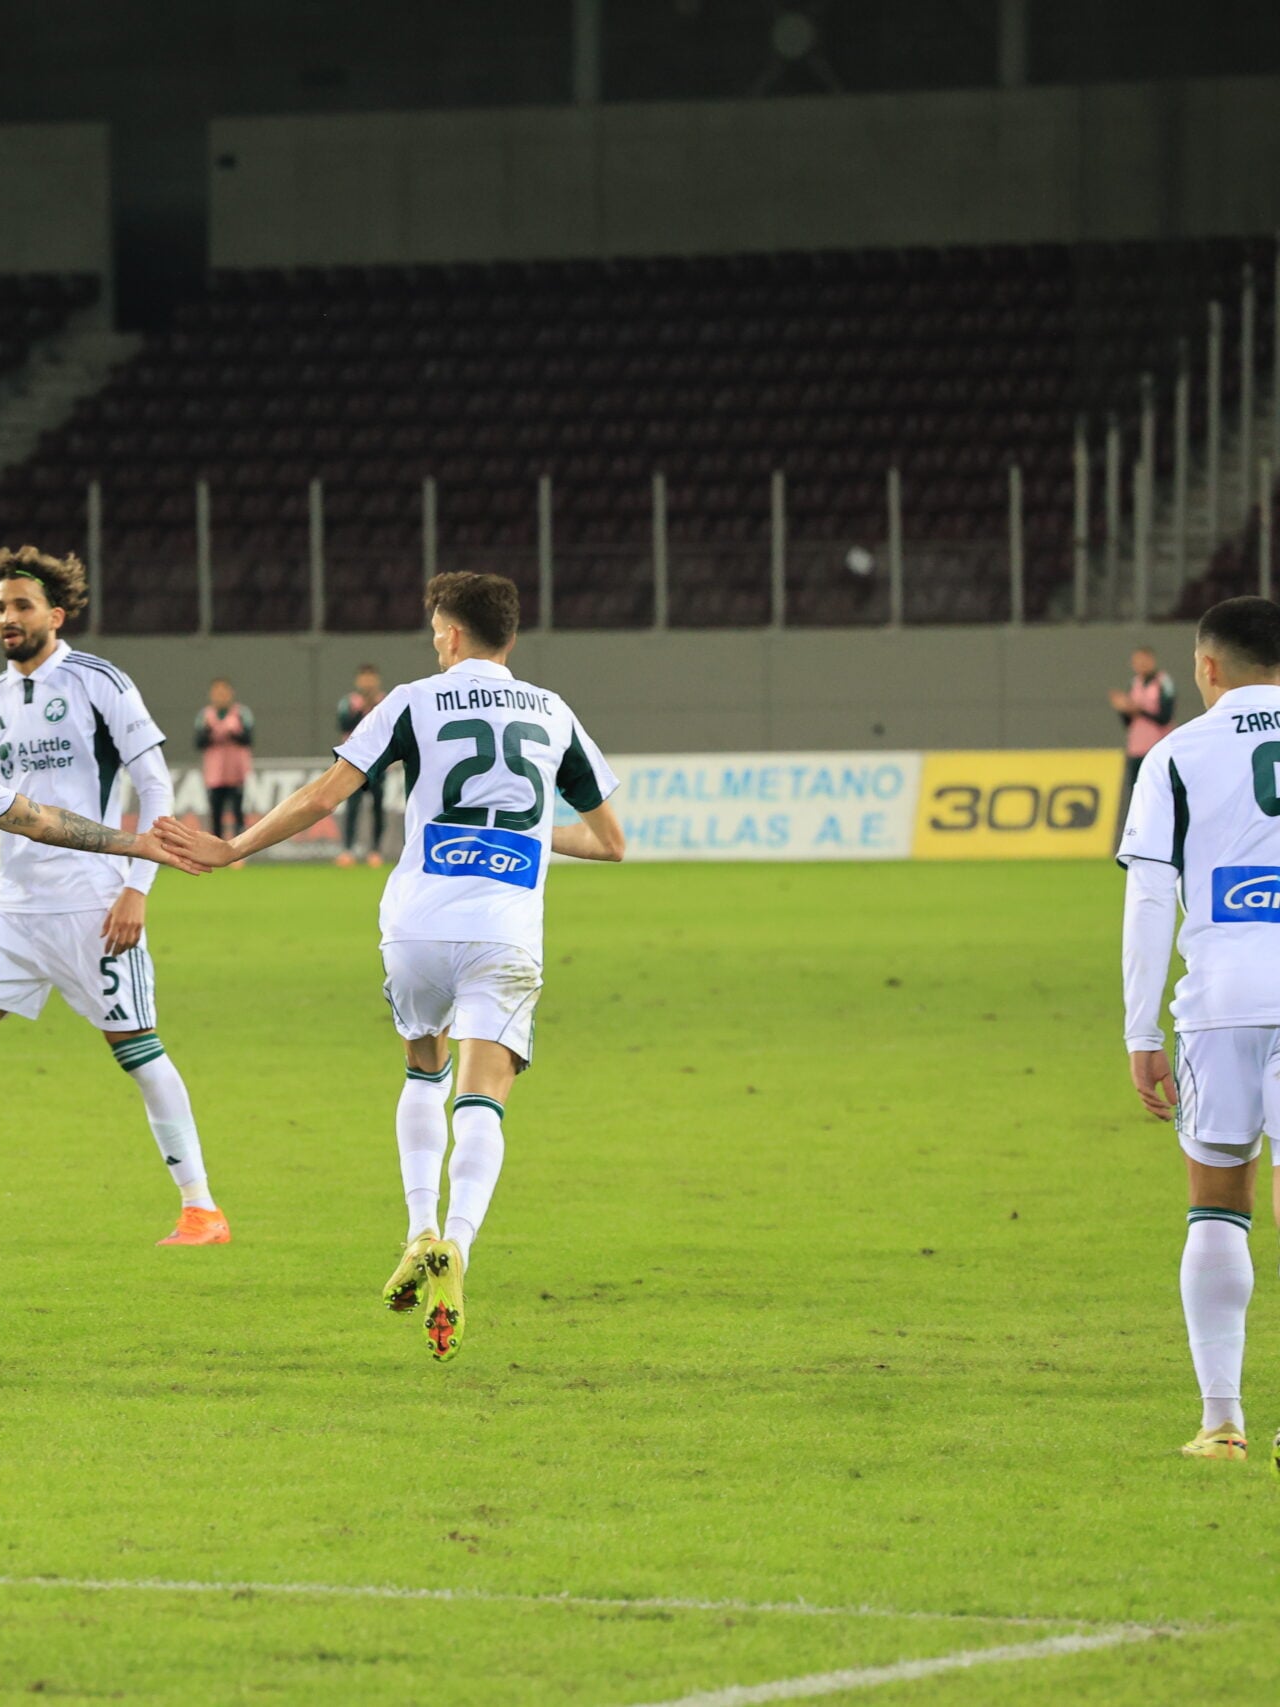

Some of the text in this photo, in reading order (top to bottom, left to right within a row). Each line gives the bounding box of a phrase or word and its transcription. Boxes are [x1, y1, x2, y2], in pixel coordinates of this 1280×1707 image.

[435, 689, 552, 716] MLADENOVIĆ
[18, 736, 71, 756] A Little
[21, 755, 74, 773] Shelter
[432, 718, 550, 831] 25
[627, 765, 904, 800] ITALMETANO
[623, 815, 792, 849] HELLAS
[431, 836, 531, 874] Car.gr
[100, 956, 120, 996] 5
